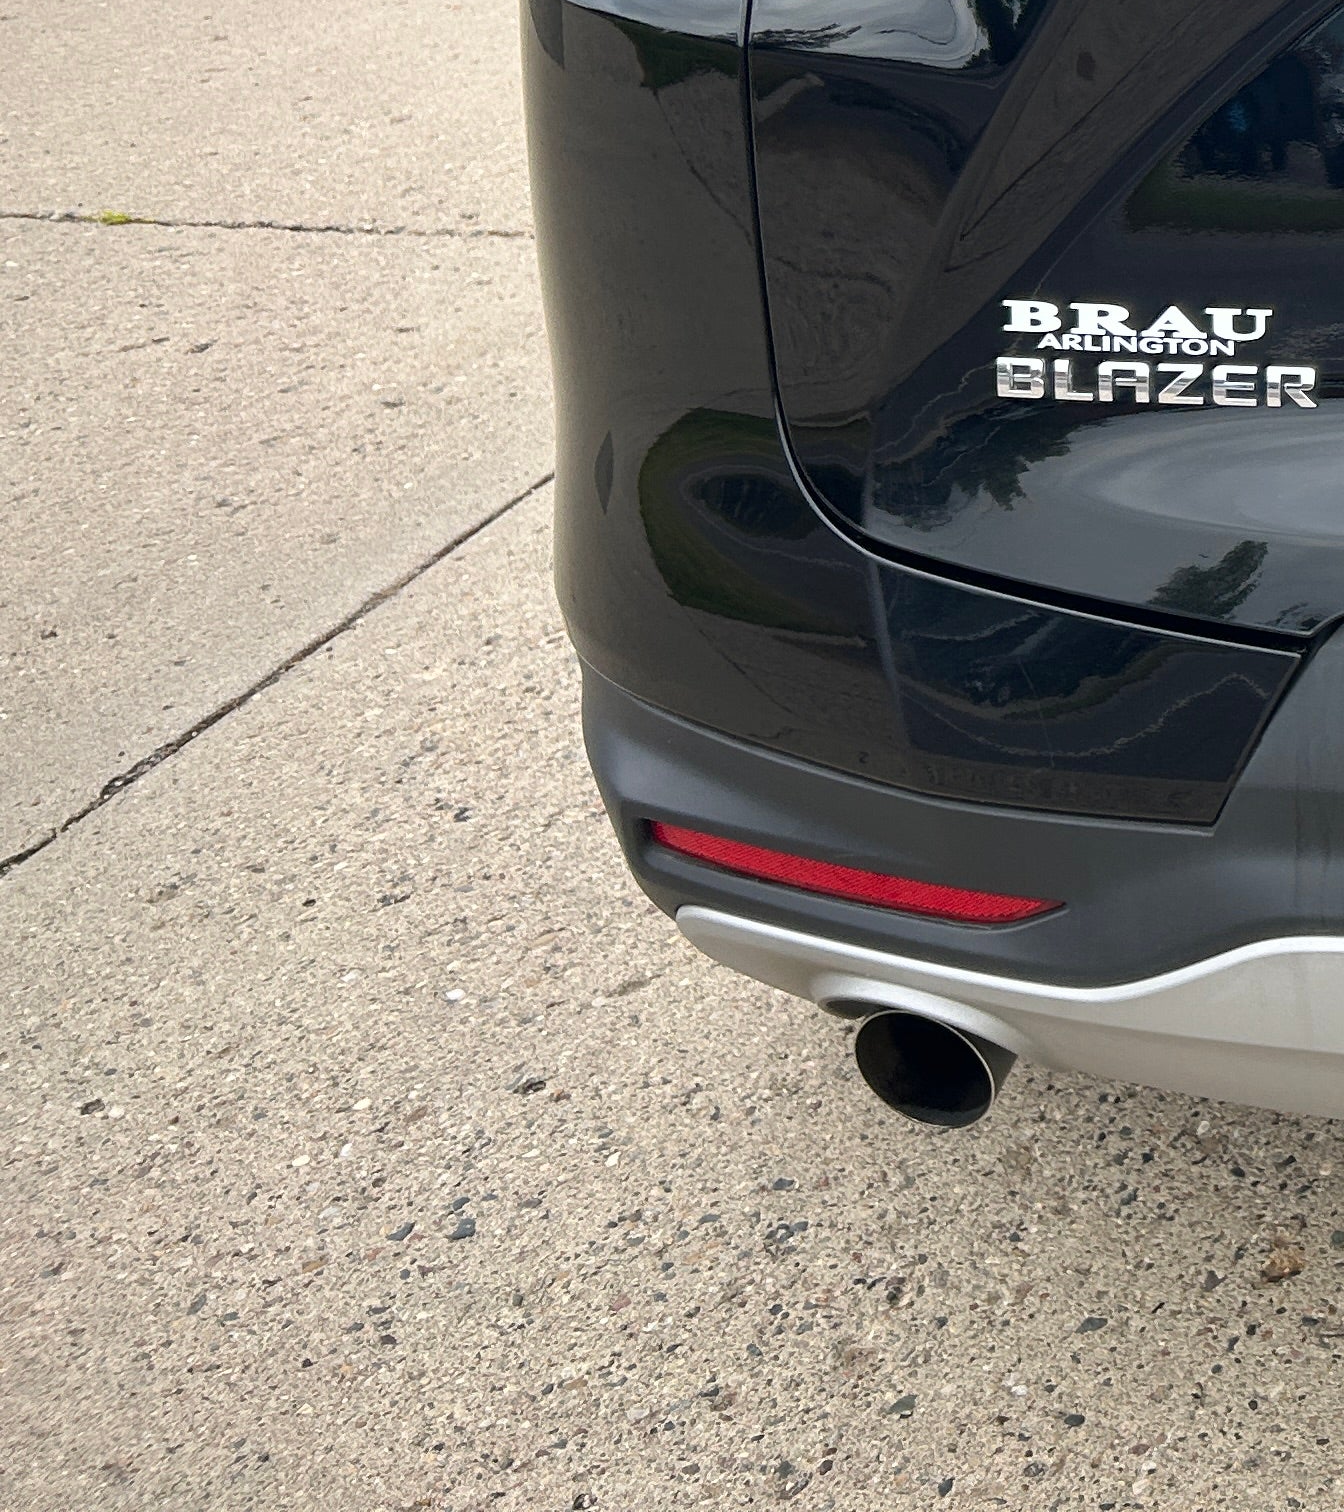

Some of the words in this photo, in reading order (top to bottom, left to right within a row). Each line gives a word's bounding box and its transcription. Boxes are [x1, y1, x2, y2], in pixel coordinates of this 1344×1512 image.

[1001, 299, 1274, 342] BRAU
[1036, 332, 1236, 356] ARLINGTON
[996, 356, 1319, 409] BLAZER
